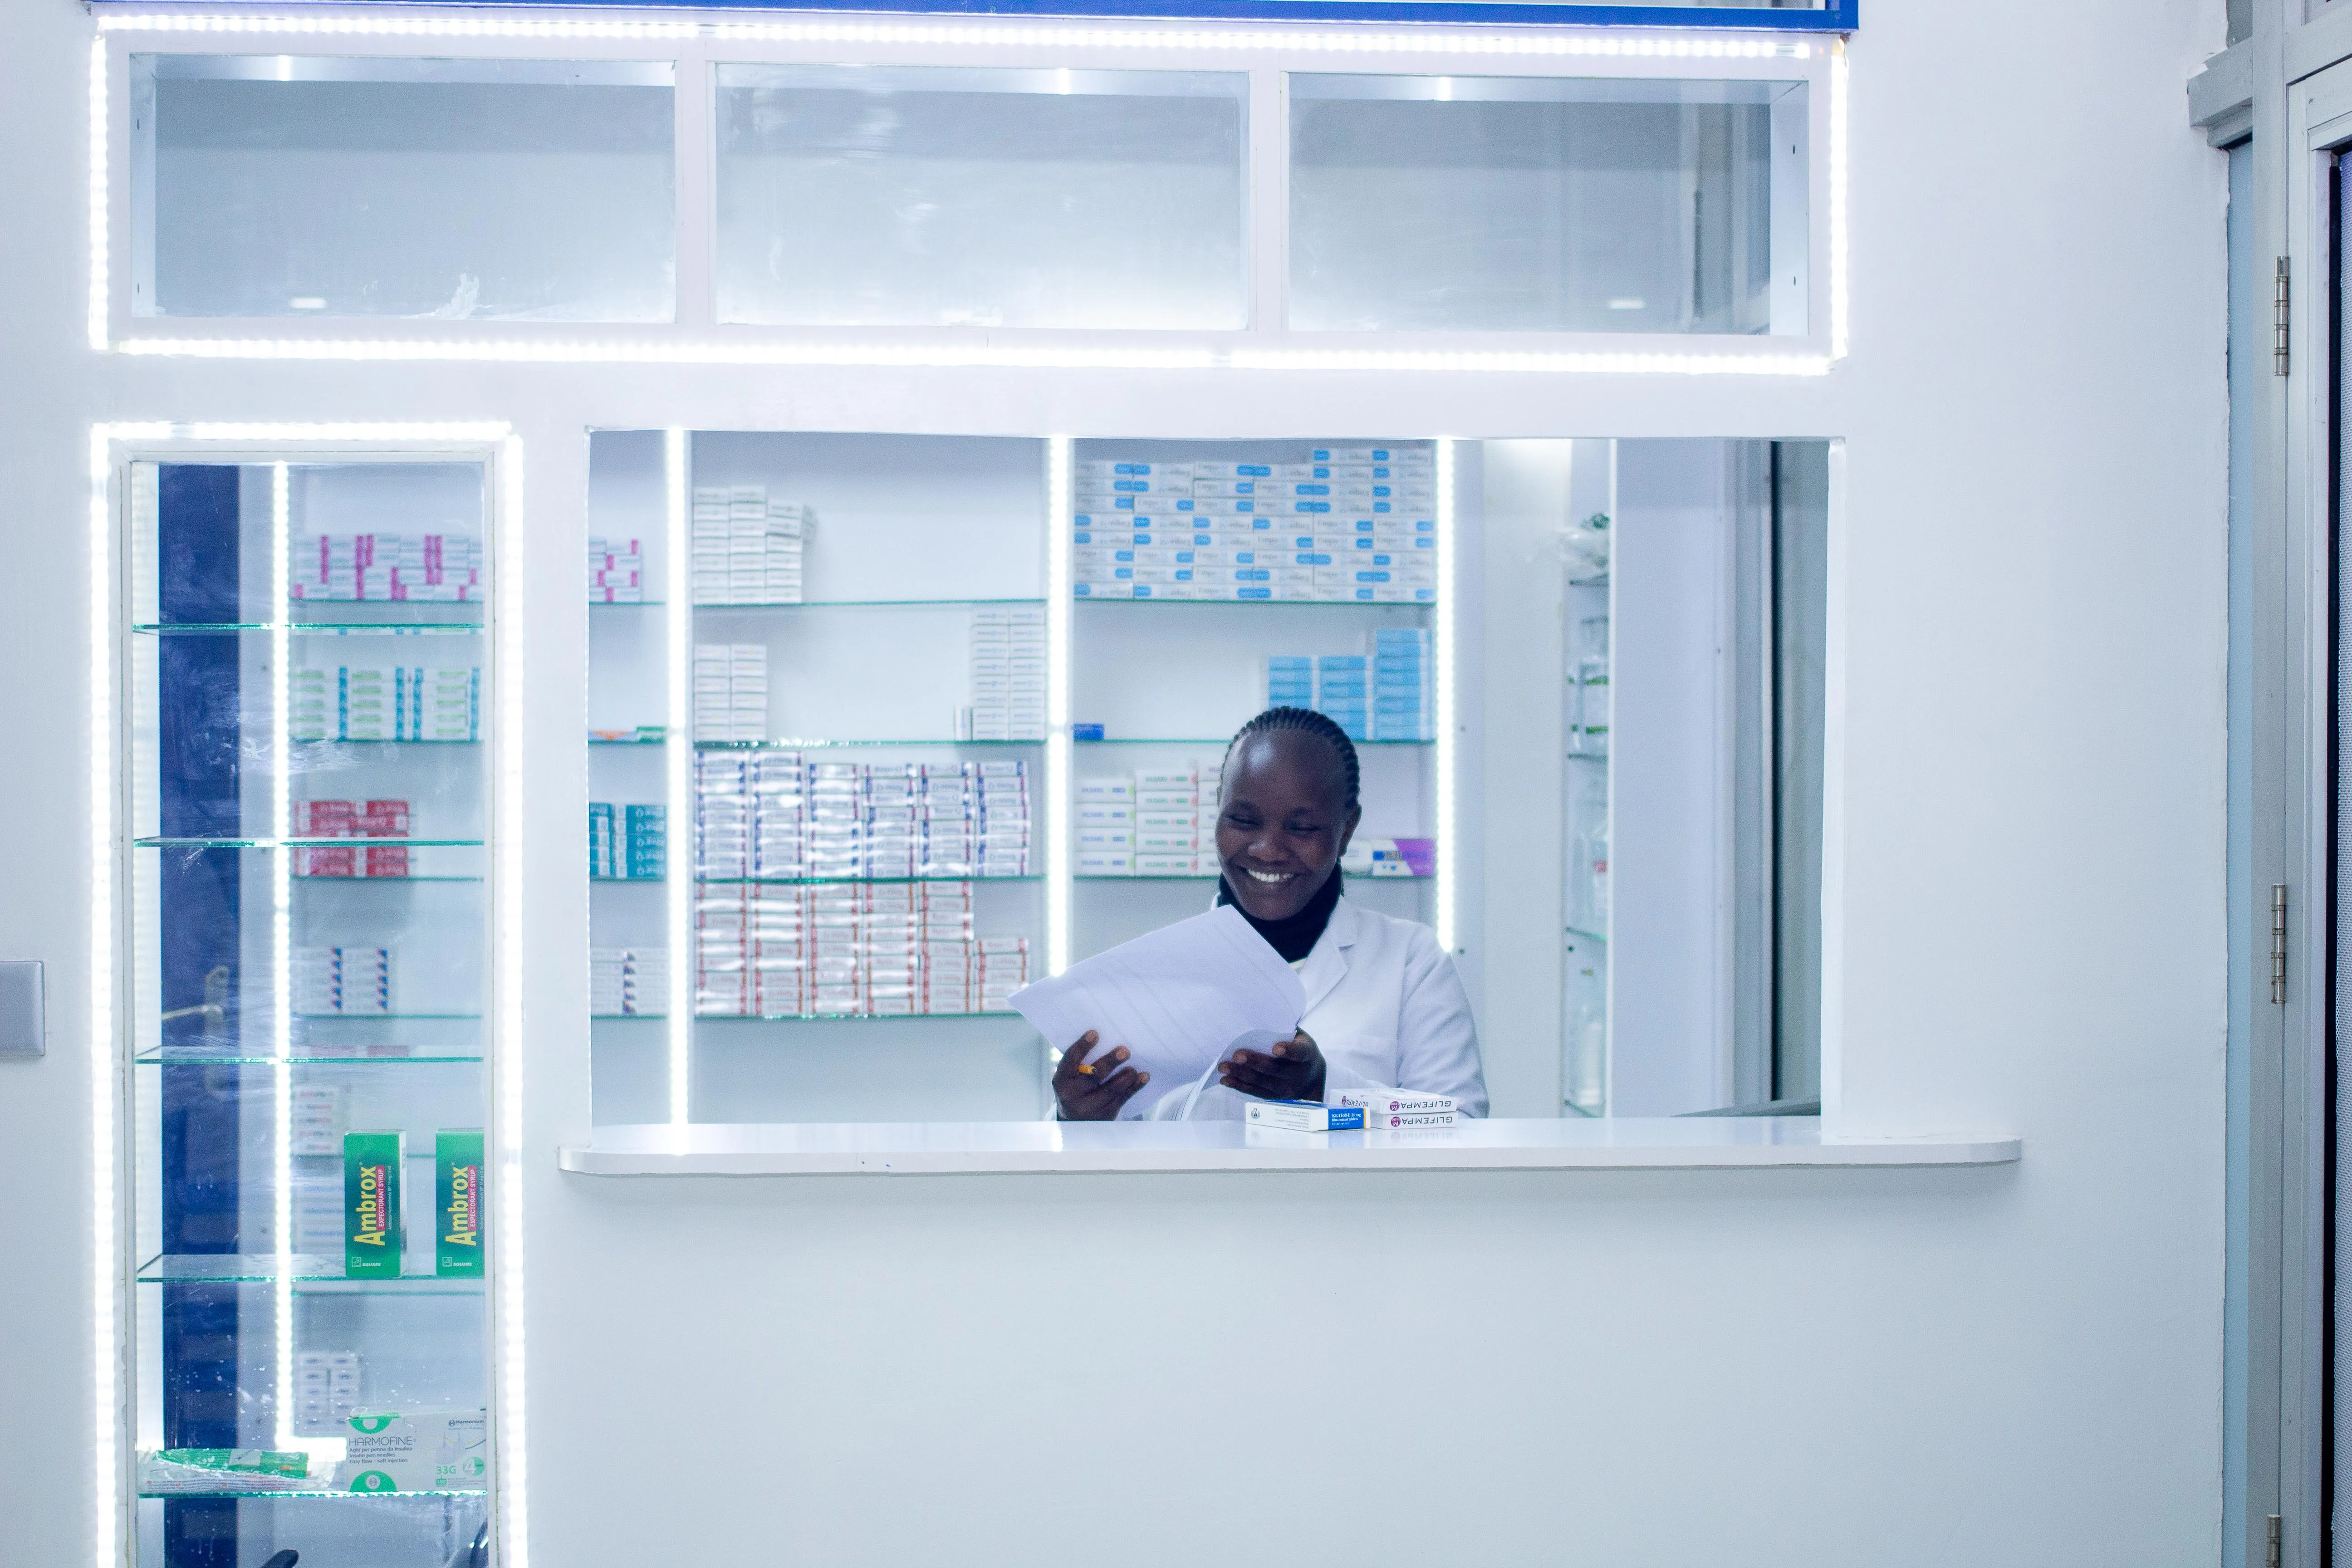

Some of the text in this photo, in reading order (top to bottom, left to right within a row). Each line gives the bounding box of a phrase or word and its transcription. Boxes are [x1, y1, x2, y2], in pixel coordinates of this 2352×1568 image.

[1346, 1098, 1369, 1107] GLIFEMPA
[1401, 1101, 1451, 1109] GLIFEMPA
[1401, 1116, 1452, 1125] GLIFEMPA
[354, 1166, 386, 1246] Ambrox
[445, 1166, 477, 1246] Ambrox
[348, 1436, 413, 1446] HARMOFINE
[436, 1465, 457, 1474] 33G
